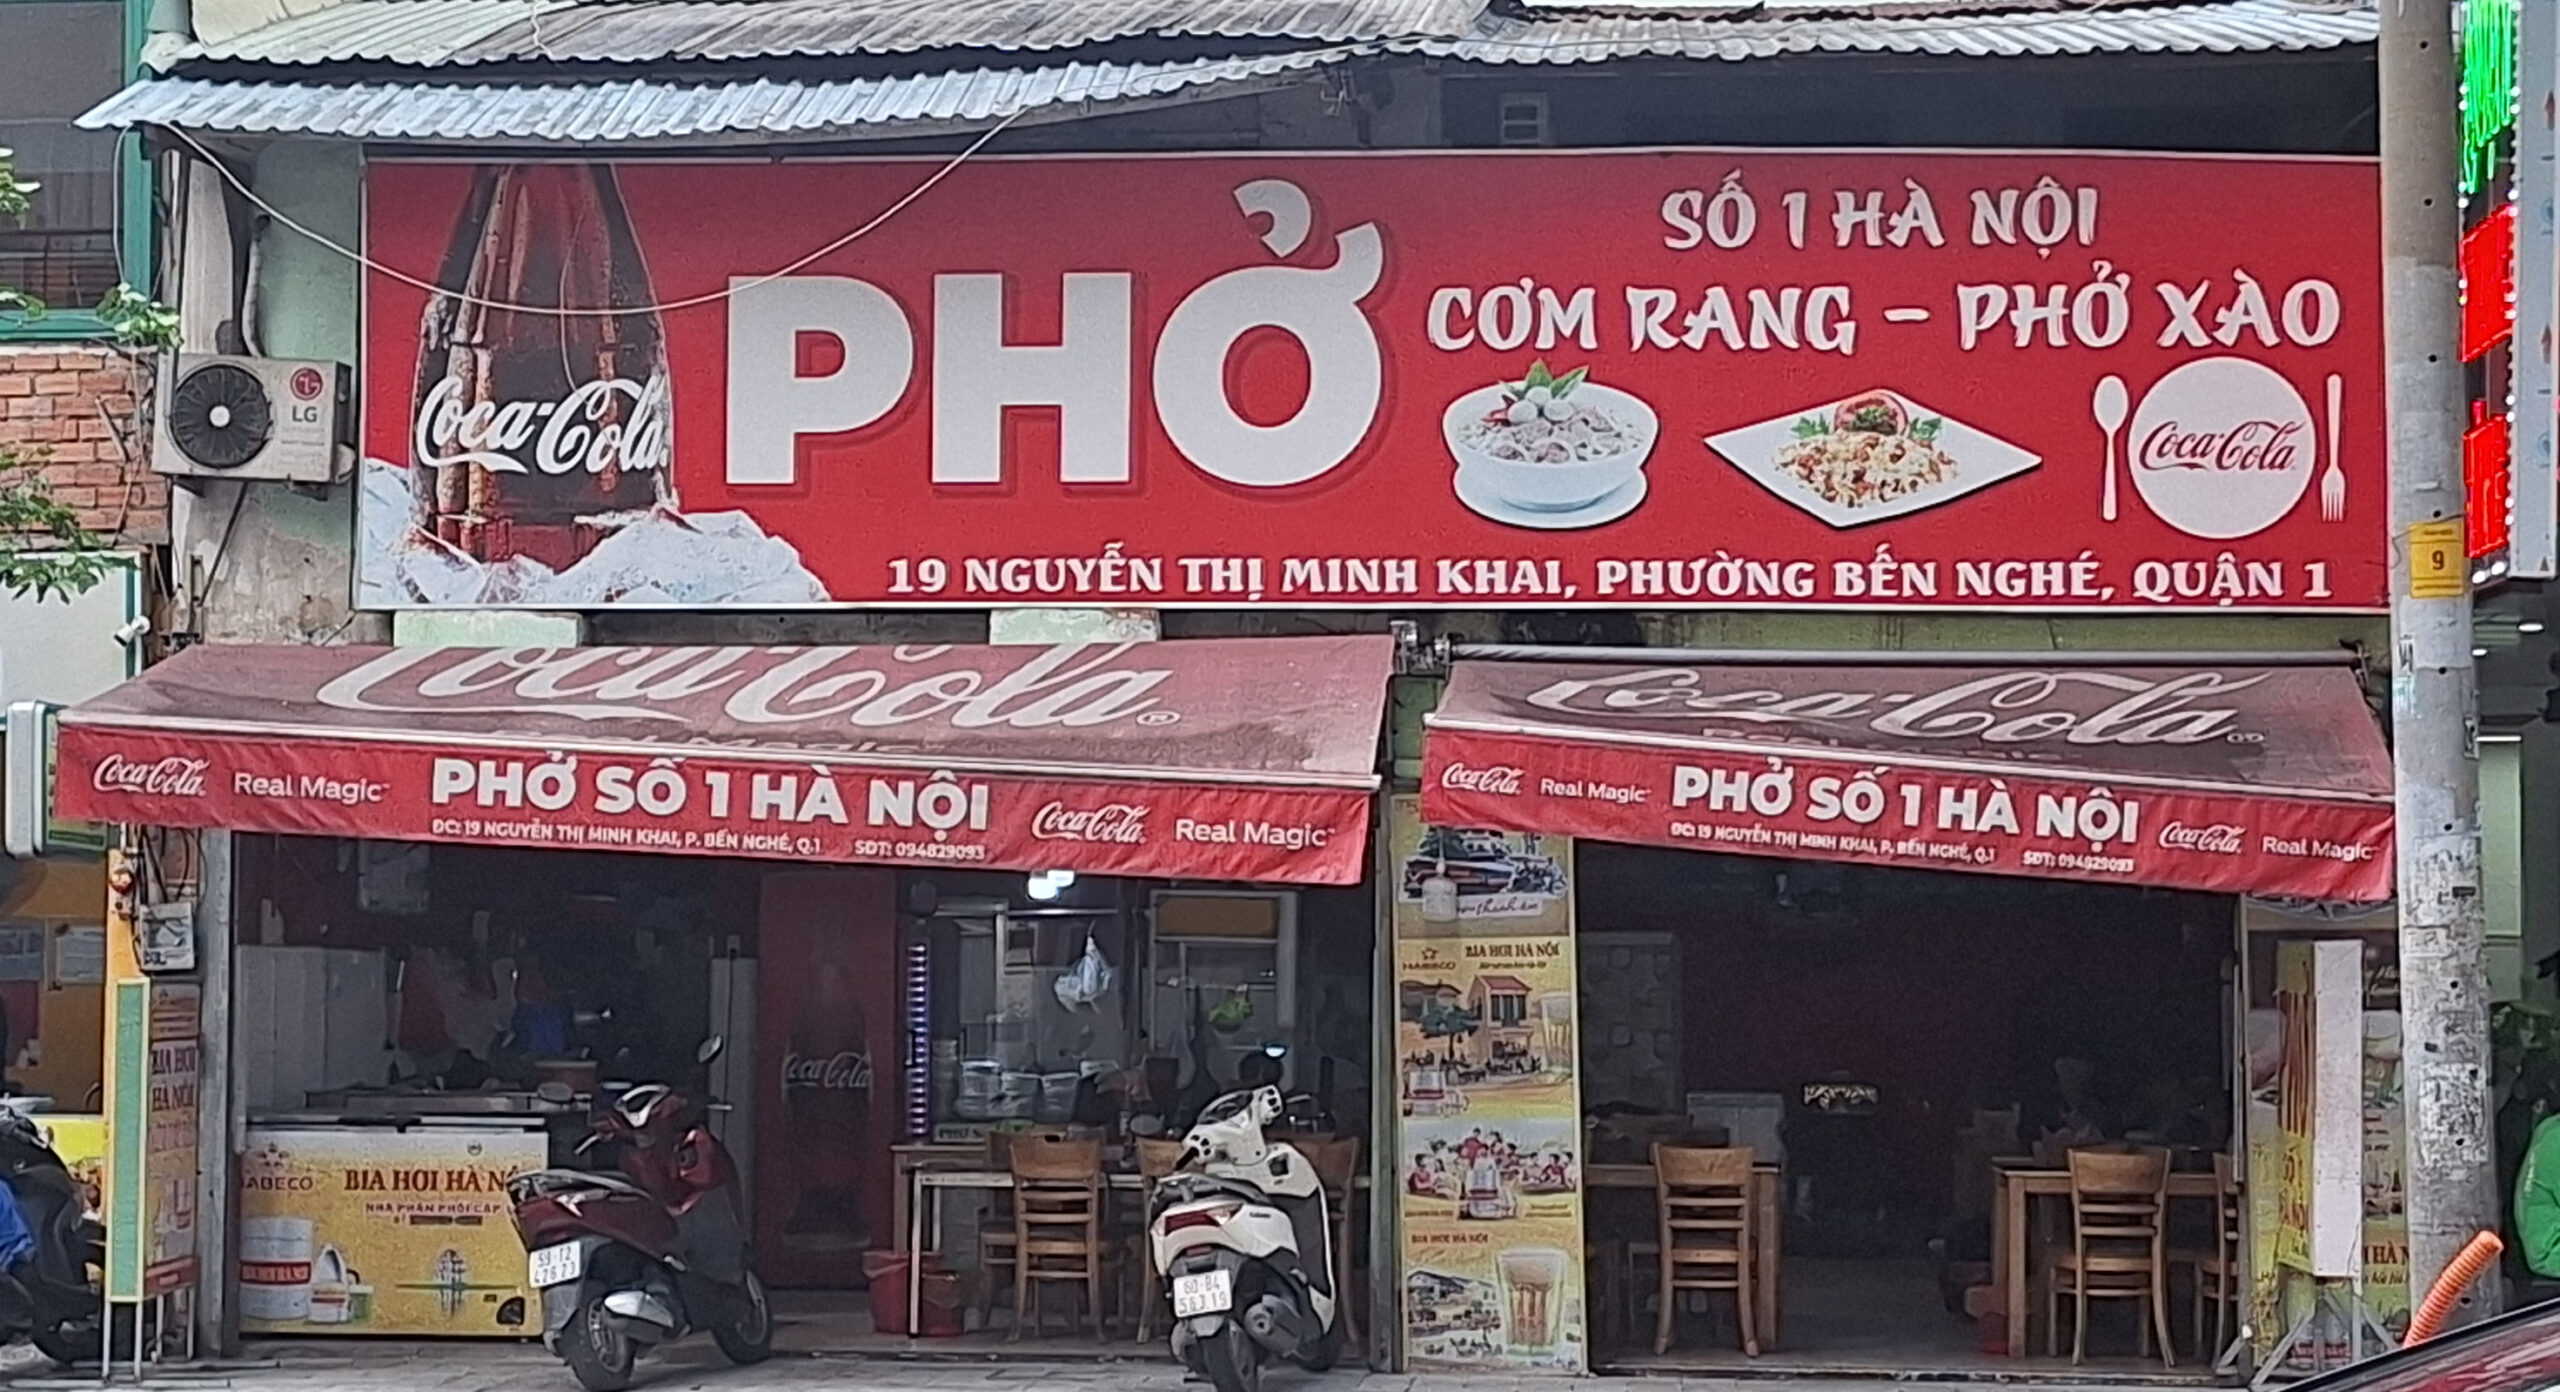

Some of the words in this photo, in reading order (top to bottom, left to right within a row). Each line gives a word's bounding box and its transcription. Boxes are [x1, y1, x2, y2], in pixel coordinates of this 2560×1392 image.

[1662, 168, 1757, 248] SỐ
[1782, 190, 1807, 248] 1
[1832, 178, 1945, 248] HÀ
[1970, 175, 2098, 258] NỘI
[726, 178, 1384, 487] PHỞ
[1427, 276, 1598, 351] CƠM
[1625, 285, 1857, 355] RANG
[1957, 260, 2131, 351] PHỞ
[2157, 267, 2341, 348] XÀO
[292, 405, 317, 422] LG
[416, 377, 670, 475] Coca-Cola
[2138, 420, 2308, 473] Coca-Cola
[887, 558, 946, 593] 19
[965, 542, 1162, 593] NGUYỄN
[1179, 558, 1265, 600] THỊ
[1281, 558, 1418, 593] MINH
[1437, 559, 1577, 598] KHAI,
[1597, 549, 1816, 597] PHƯỜNG
[1834, 543, 1937, 597] BẾN
[1955, 551, 2113, 601] NGHÉ,
[2133, 552, 2284, 605] QUẬN
[2304, 562, 2332, 598] 1
[2431, 549, 2445, 571] 9
[1526, 667, 2272, 745] Coca-Cola
[93, 754, 212, 796] Coca-Cola
[234, 772, 294, 798] Real
[300, 775, 383, 804] Magic
[432, 750, 580, 812] PHỞ
[595, 757, 690, 817] SỐ
[703, 772, 730, 818] 1
[750, 764, 848, 826] HÀ
[866, 770, 989, 843] NỘI
[1442, 762, 1525, 794] Coca-Cola
[1540, 777, 1584, 798] Real
[1588, 782, 1647, 804] Magic
[1672, 756, 1794, 817] PHỞ
[1807, 766, 1890, 824] SỐ
[1900, 786, 1922, 827] 1
[1937, 779, 2020, 837] HÀ
[2036, 787, 2140, 852] NỘI
[464, 820, 481, 836] 19
[588, 826, 632, 845] MINH
[1031, 802, 1148, 844] Coca-Cola
[1175, 818, 1237, 844] Real
[1242, 822, 1328, 850] Magic
[2159, 821, 2247, 855] Coca-Cola
[2262, 835, 2308, 857] Real
[2312, 838, 2374, 861] Magic
[344, 1169, 386, 1191] BIA
[392, 1169, 439, 1192] HƠI
[444, 1164, 483, 1192] HÀ
